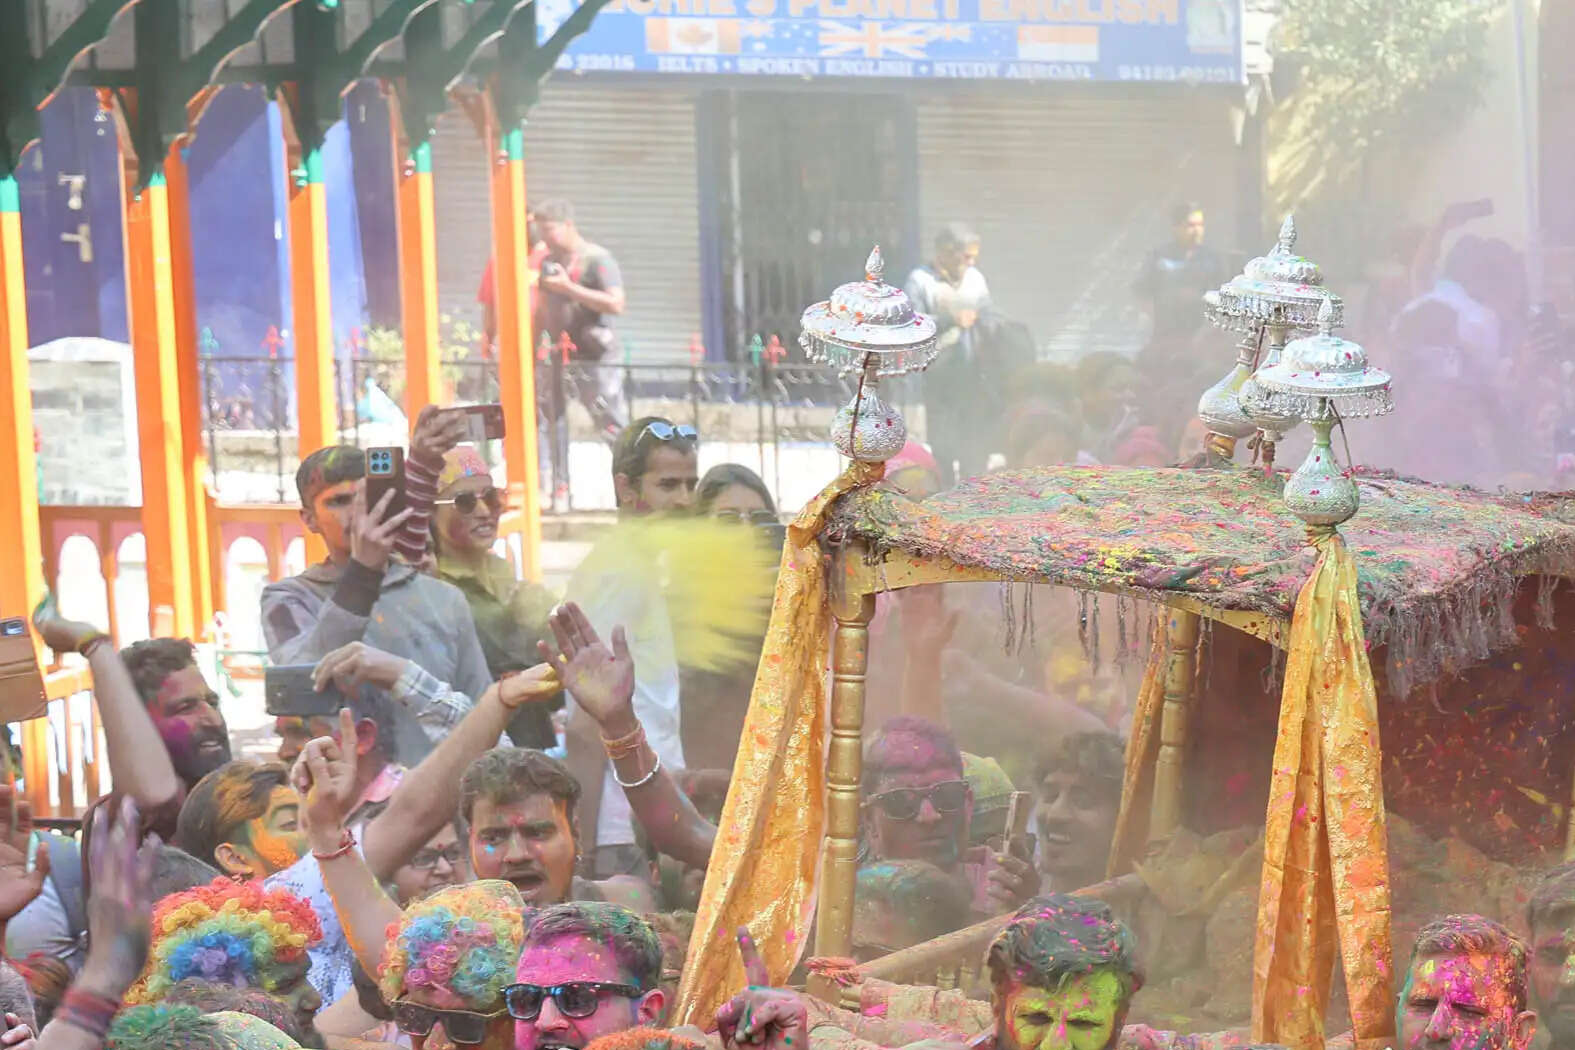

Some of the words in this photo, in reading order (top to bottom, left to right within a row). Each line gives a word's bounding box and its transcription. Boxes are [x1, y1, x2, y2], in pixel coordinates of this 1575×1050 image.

[657, 55, 718, 73] IELTS
[737, 57, 820, 75] SPOKEN
[824, 59, 914, 77] ENGLISH
[932, 62, 1001, 79] STUDY
